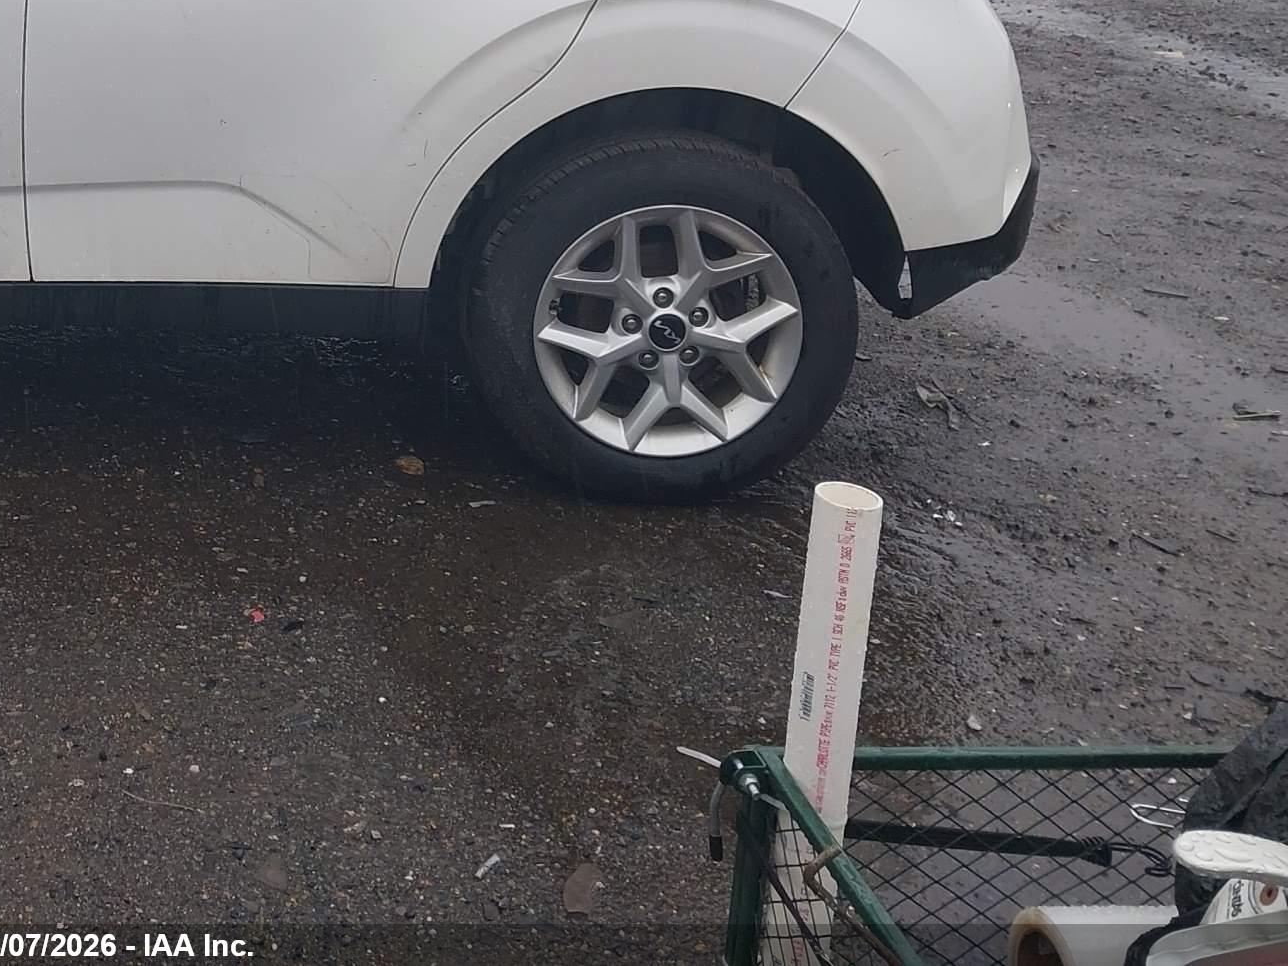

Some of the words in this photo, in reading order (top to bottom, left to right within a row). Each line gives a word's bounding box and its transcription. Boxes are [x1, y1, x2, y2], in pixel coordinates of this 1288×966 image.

[832, 623, 844, 635] SCH
[829, 642, 842, 657] TYPE
[828, 659, 840, 671] PVC
